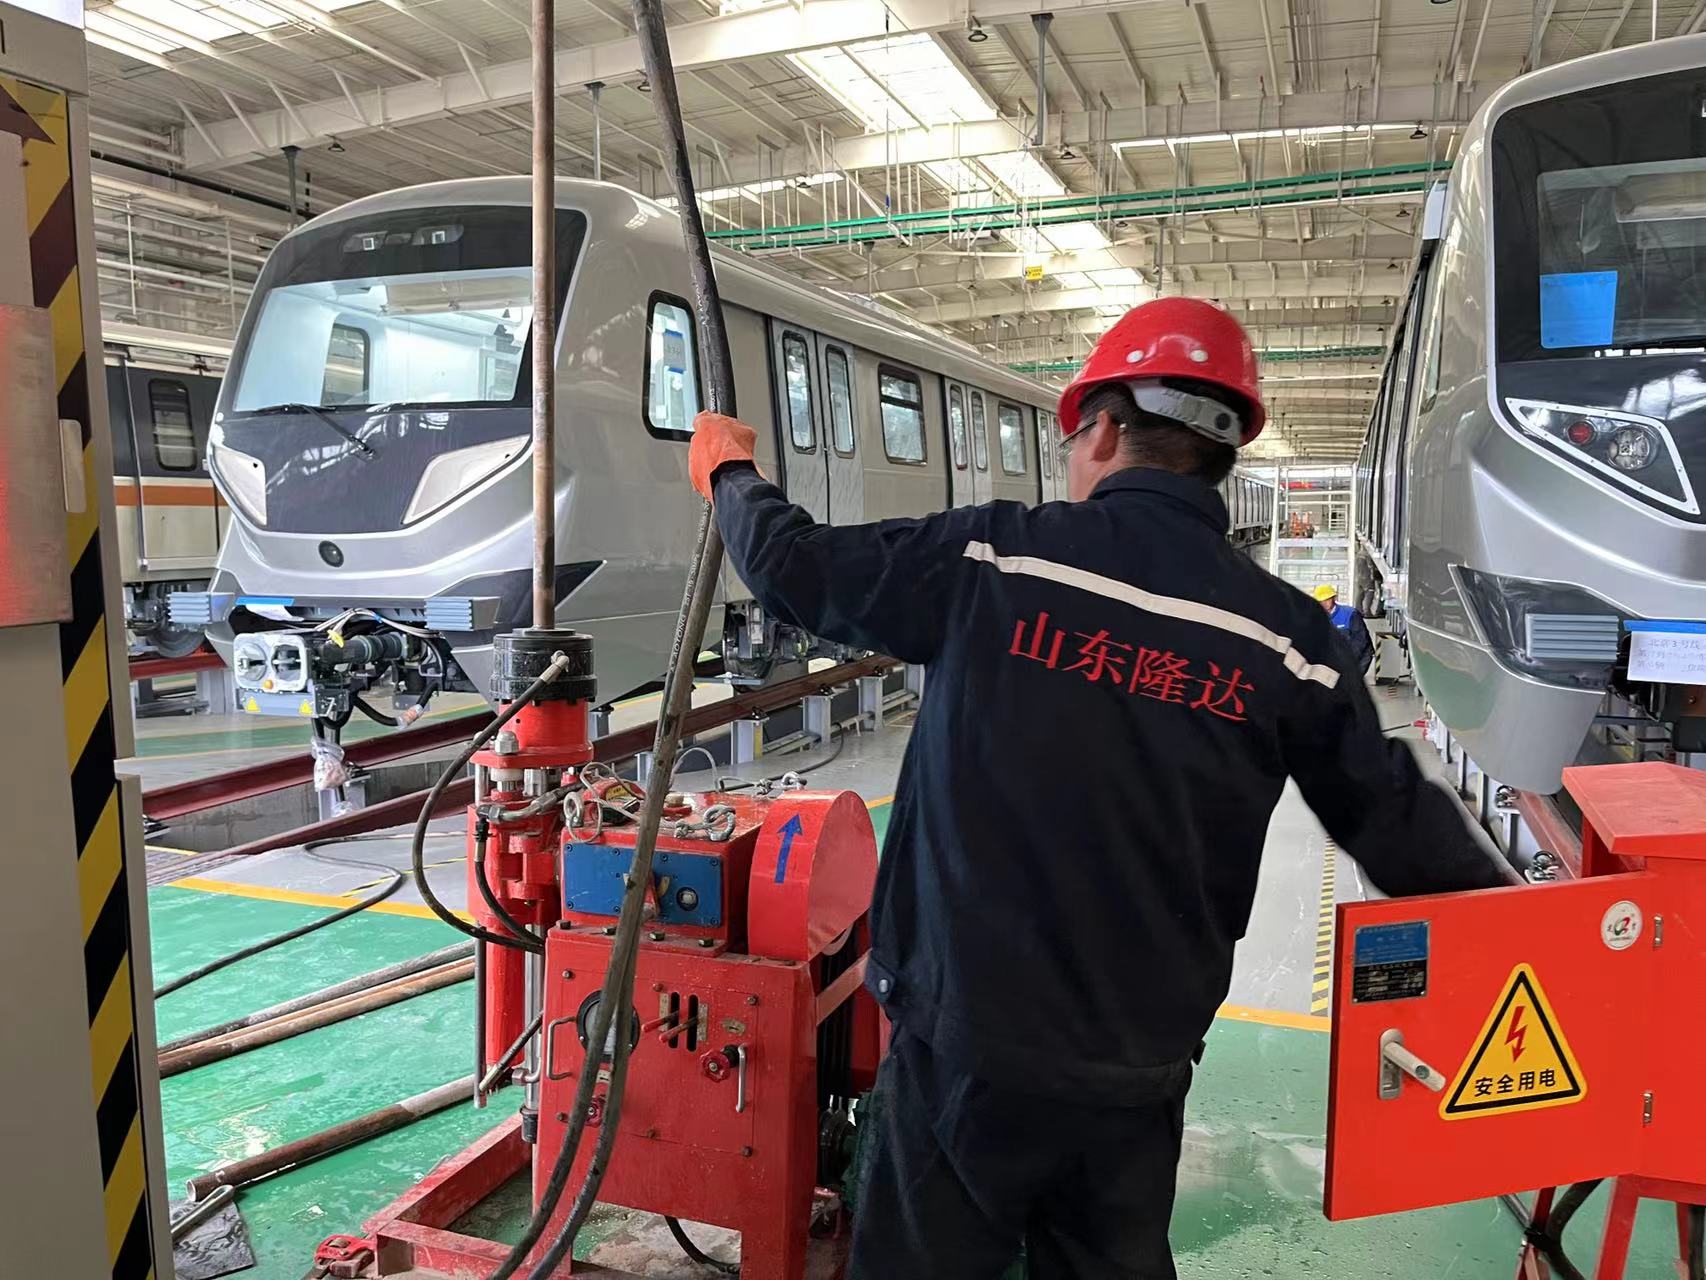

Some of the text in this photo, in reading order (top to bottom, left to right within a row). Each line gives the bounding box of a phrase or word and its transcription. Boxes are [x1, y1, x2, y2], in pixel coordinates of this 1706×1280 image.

[1009, 612, 1254, 722] 山东隆达
[1474, 1068, 1556, 1097] 安全用电
